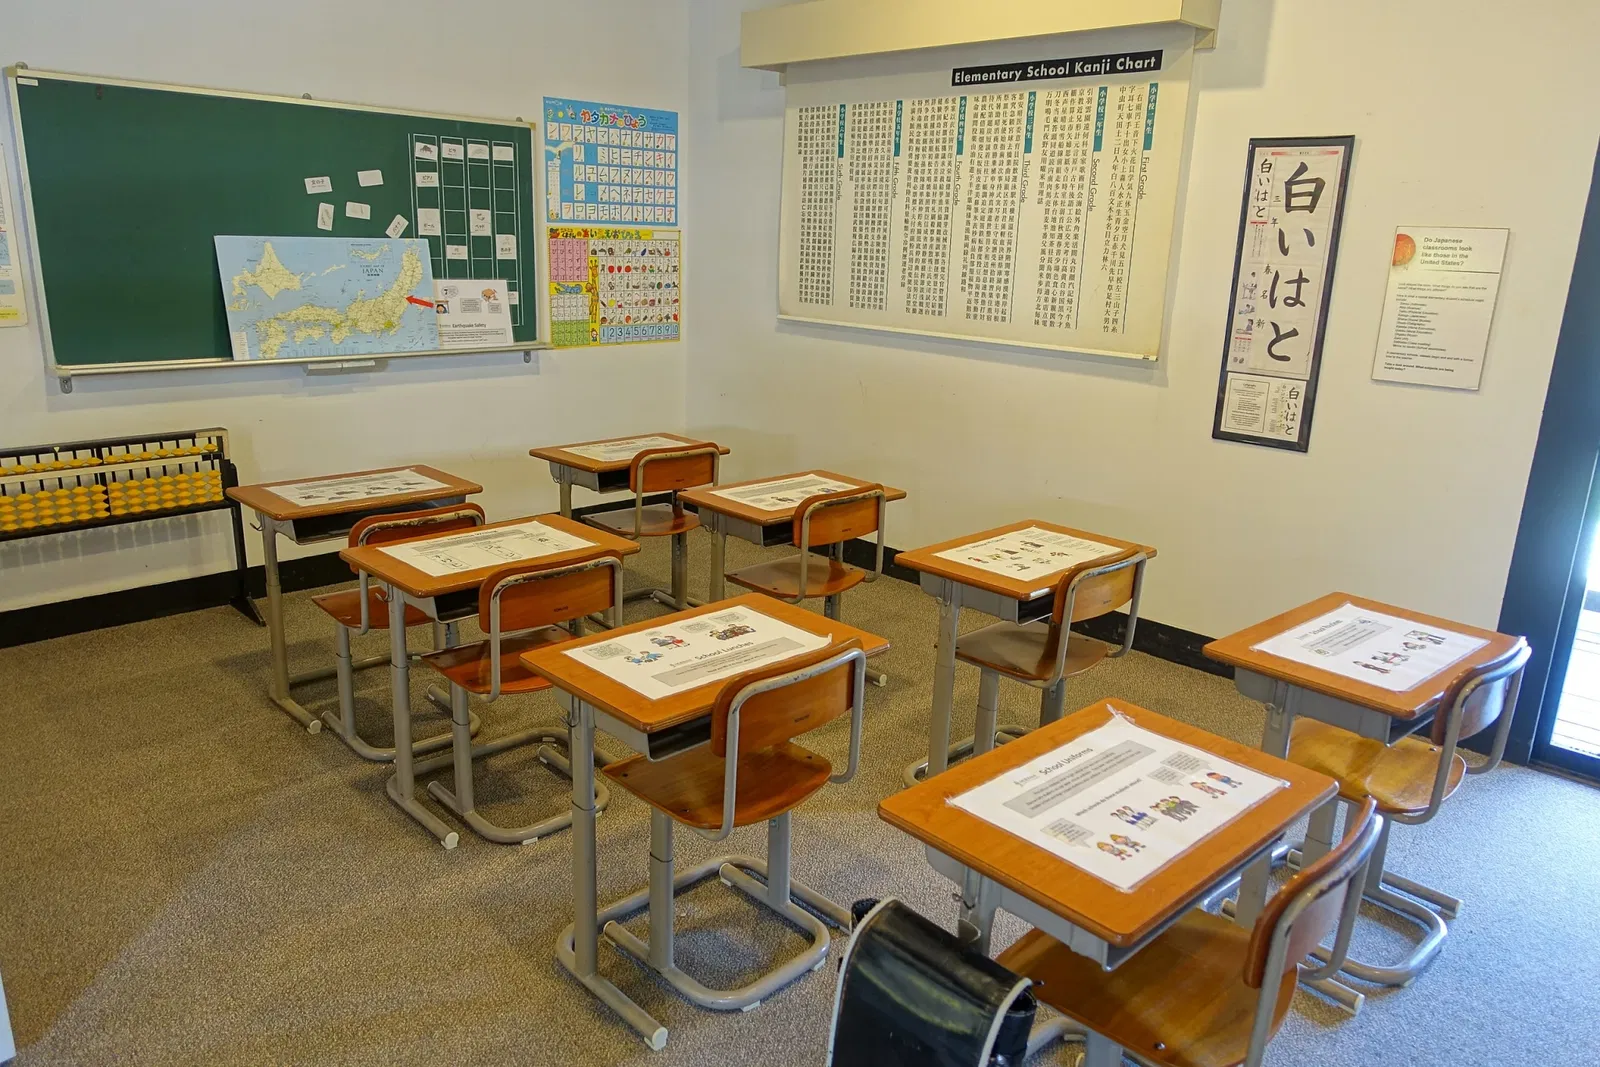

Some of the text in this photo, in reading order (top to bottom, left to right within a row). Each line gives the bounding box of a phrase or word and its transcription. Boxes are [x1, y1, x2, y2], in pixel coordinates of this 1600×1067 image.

[955, 56, 1156, 83] Elementary School Kanji Chart
[1020, 179, 1028, 203] Grade
[1088, 159, 1100, 211] Second Grade
[1138, 175, 1147, 199] Grade
[1255, 158, 1272, 218] 白いはと
[1267, 161, 1326, 362] 白いはと
[602, 324, 678, 338] 1 2 3 4 5 6 7 8 9 10
[1285, 387, 1300, 435] 白いはと
[694, 642, 754, 660] School Lunches
[1039, 762, 1061, 775] School
[1062, 748, 1093, 765] Uniforms
